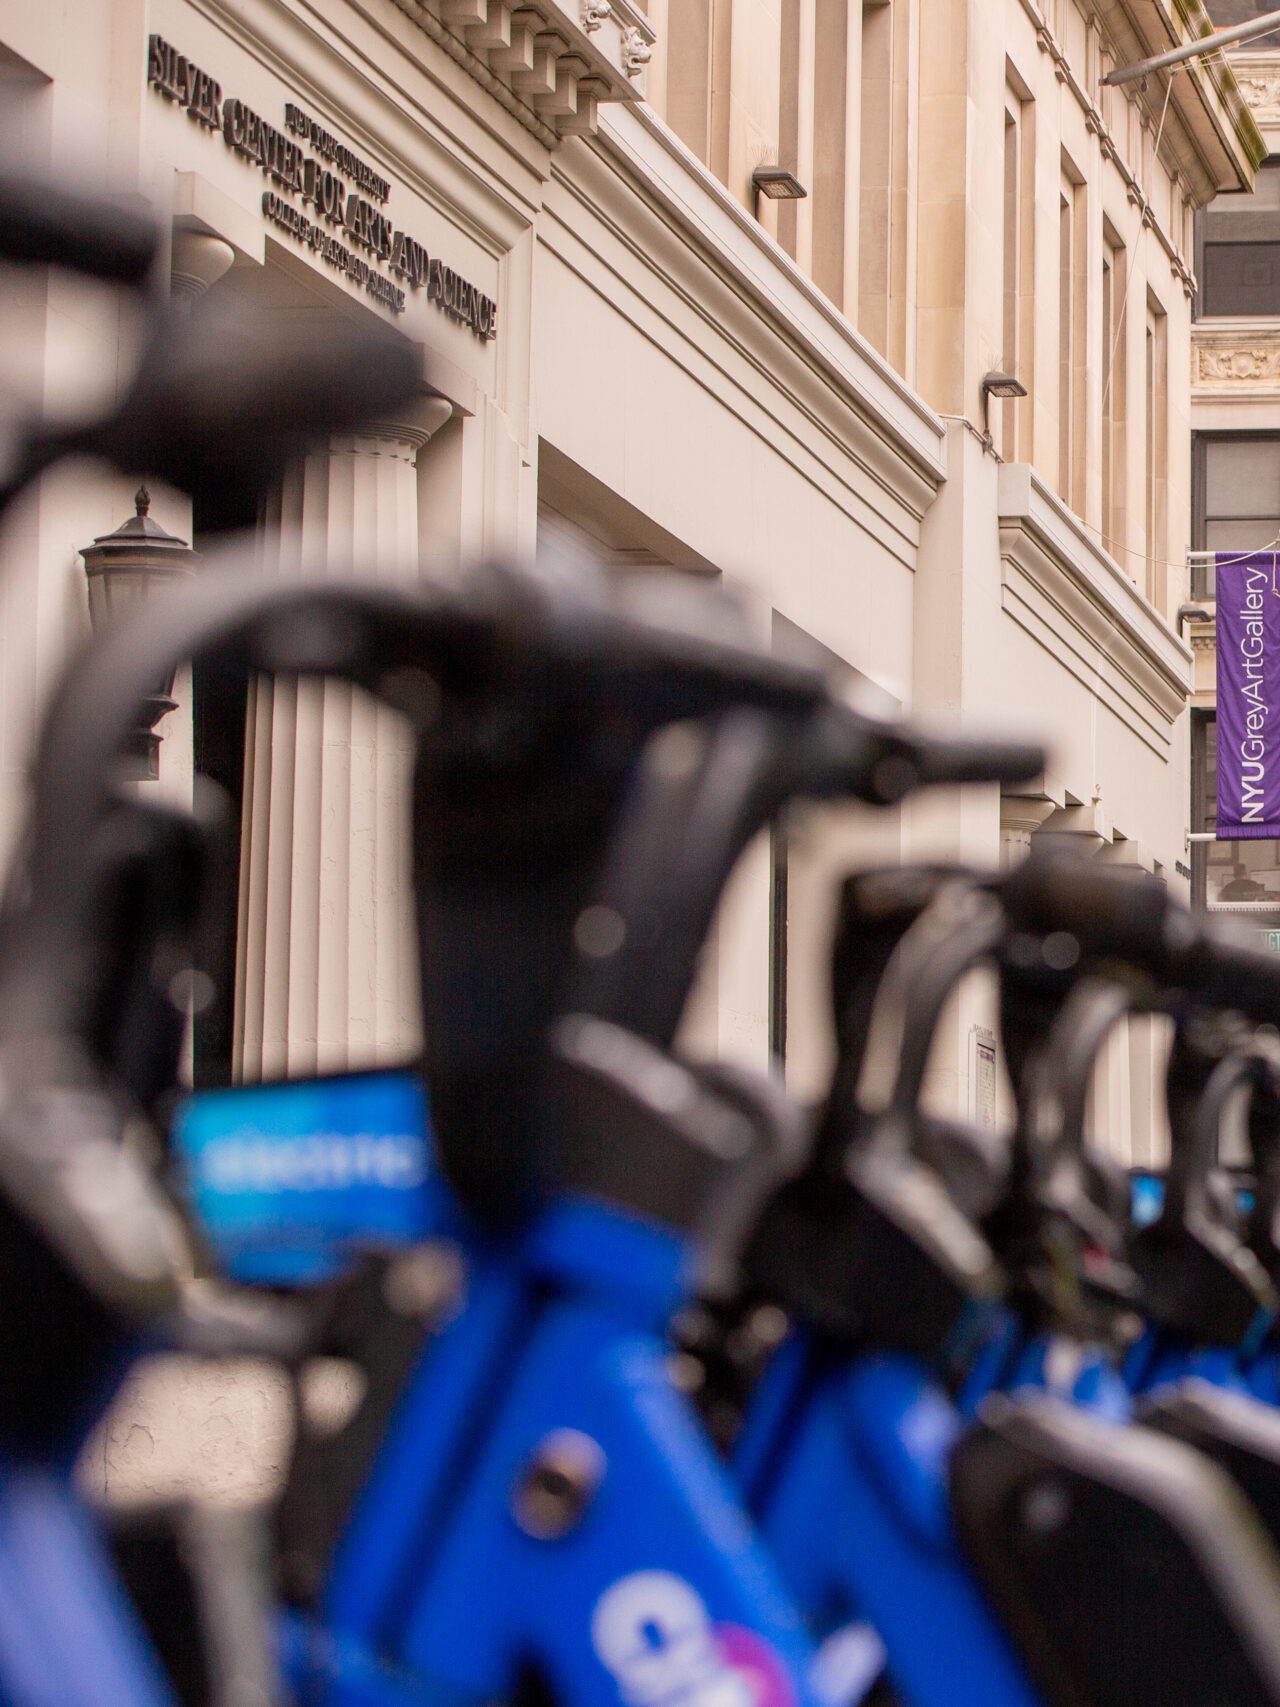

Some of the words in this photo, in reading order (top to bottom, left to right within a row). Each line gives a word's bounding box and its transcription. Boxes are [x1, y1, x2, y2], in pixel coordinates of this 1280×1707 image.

[148, 34, 222, 133] SILVER
[222, 98, 303, 194] CENTER
[302, 158, 345, 226] FOR
[343, 194, 392, 260] ARTS
[388, 231, 428, 289] AND
[427, 259, 497, 341] SCIENCE
[285, 103, 312, 138] NEW
[310, 122, 339, 163] YORK
[336, 145, 391, 203] UNIVERSITY
[262, 192, 312, 243] COLLEGE
[309, 226, 326, 251] OF
[322, 237, 350, 270] ARTS
[366, 270, 405, 312] SCIENCE
